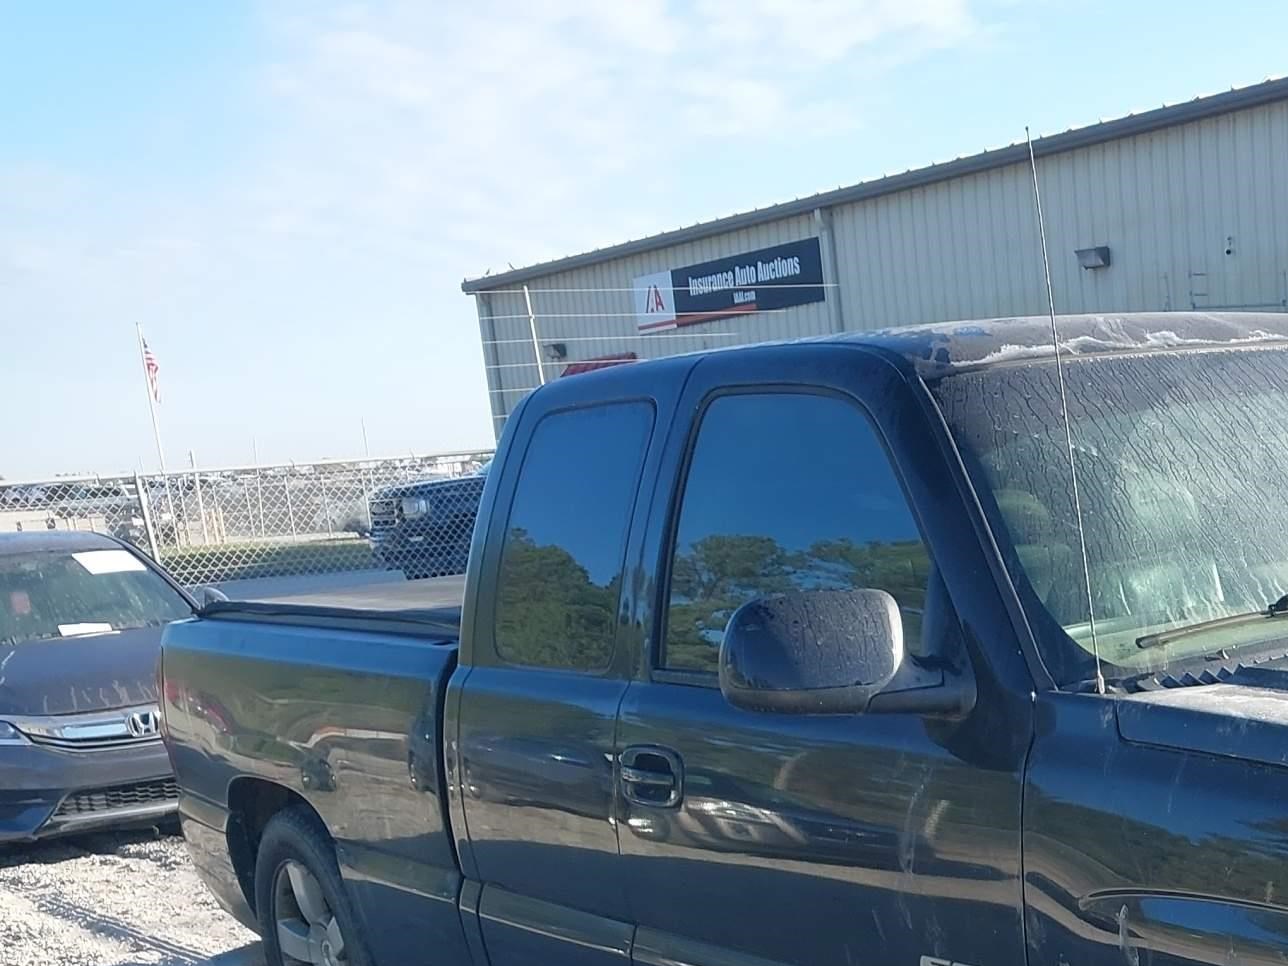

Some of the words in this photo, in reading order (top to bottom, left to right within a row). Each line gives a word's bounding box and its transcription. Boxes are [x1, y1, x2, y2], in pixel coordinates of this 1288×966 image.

[687, 269, 735, 296] Insurance
[734, 265, 757, 287] Auto
[757, 256, 801, 283] Auctions
